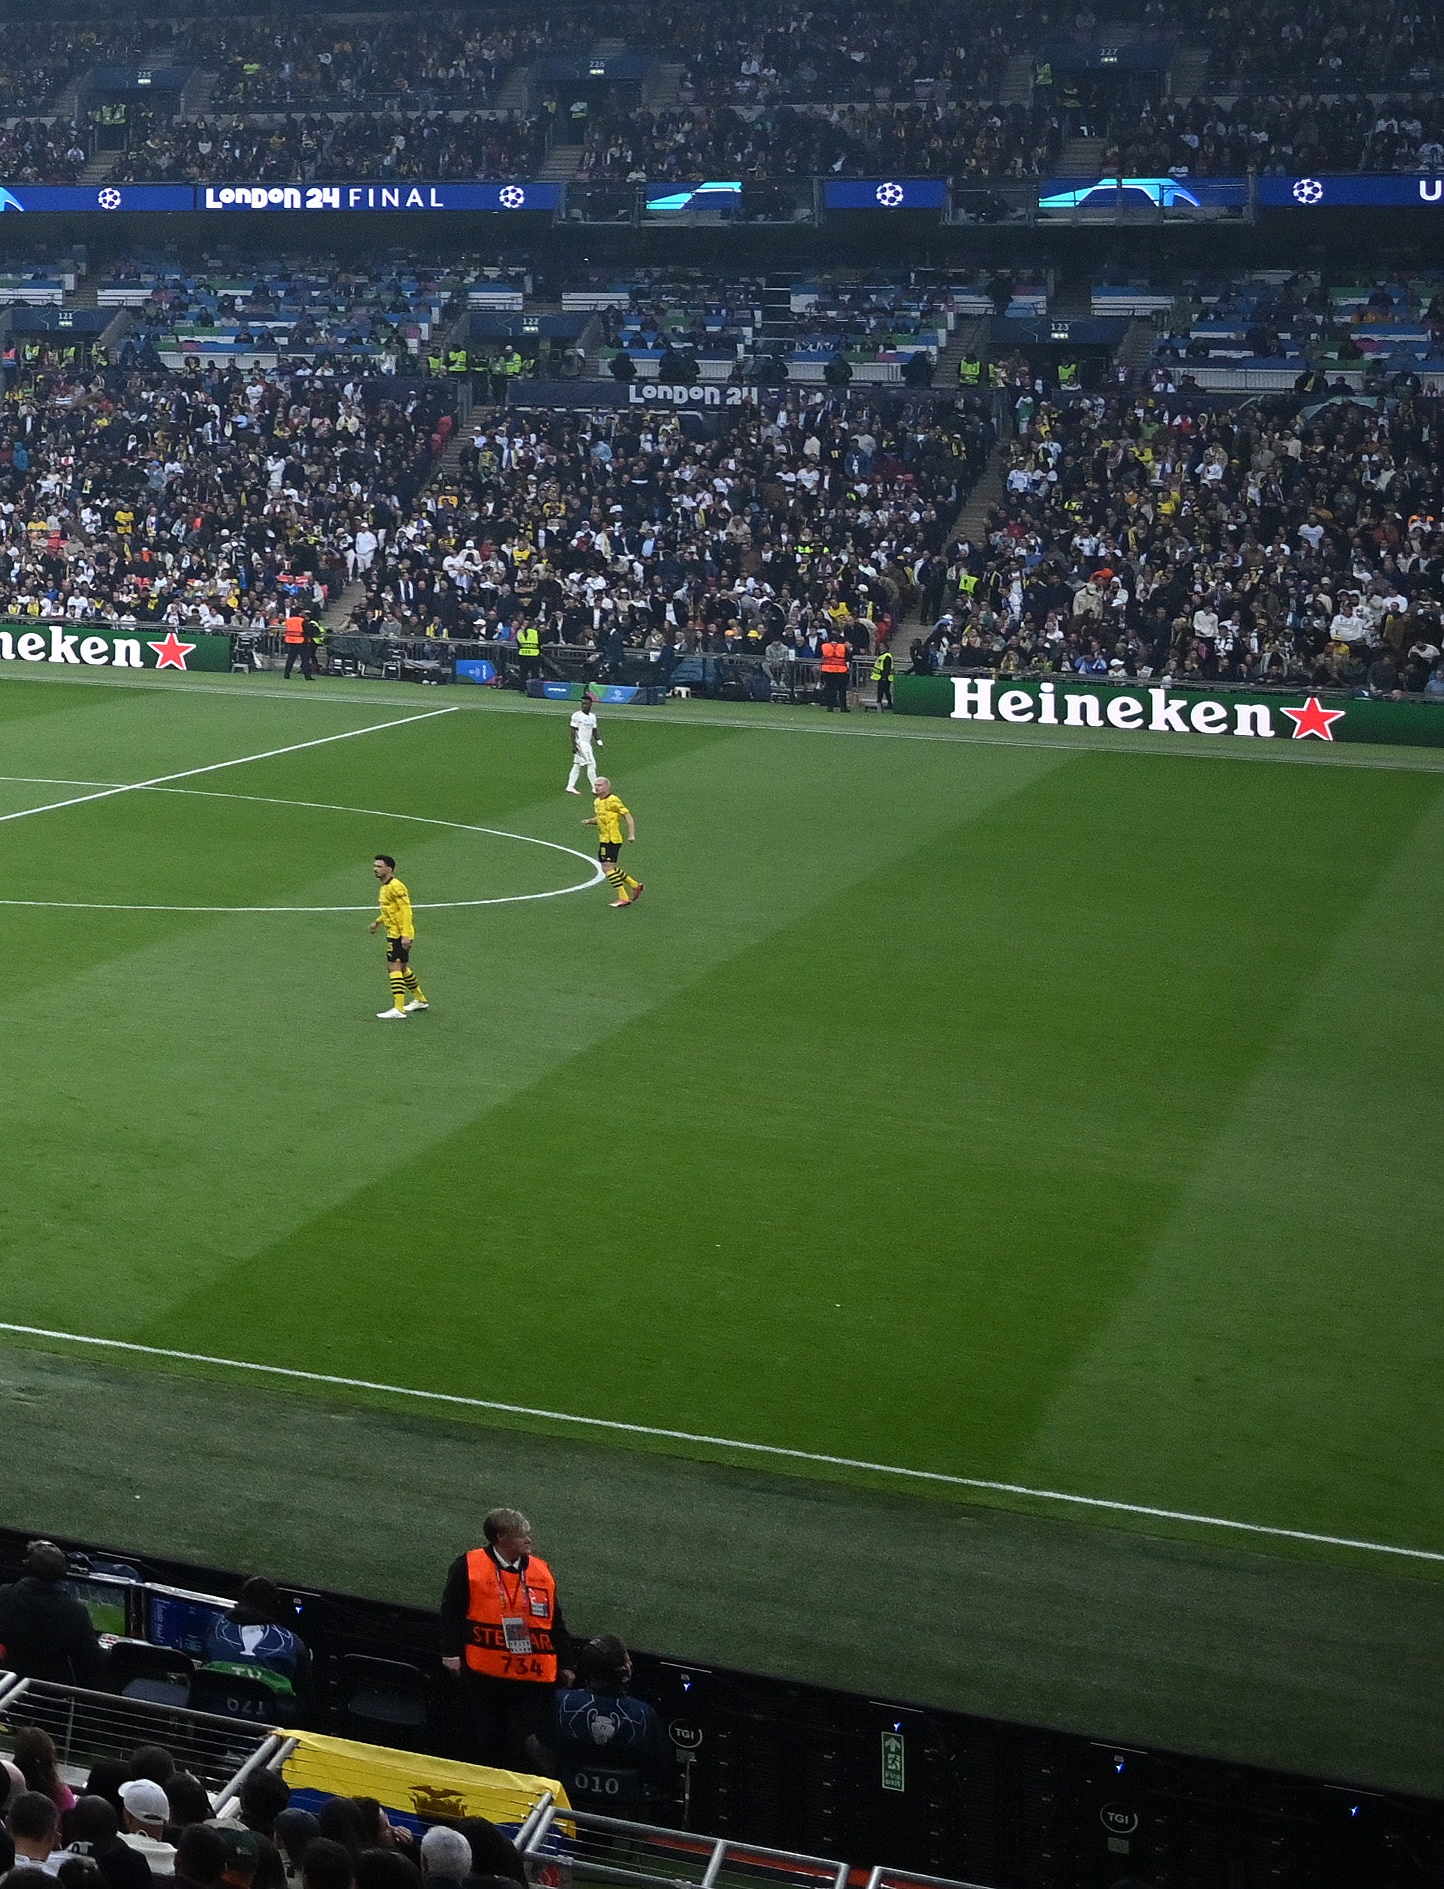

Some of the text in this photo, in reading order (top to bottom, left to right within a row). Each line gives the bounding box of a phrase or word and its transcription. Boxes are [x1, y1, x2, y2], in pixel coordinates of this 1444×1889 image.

[1100, 48, 1118, 56] 227
[589, 60, 605, 68] 226
[205, 188, 444, 209] London 24 FINAL
[522, 317, 539, 325] 122
[1051, 323, 1069, 331] 123
[629, 384, 720, 405] London
[724, 385, 758, 406] 24
[950, 676, 1276, 740] Heineken
[472, 1626, 554, 1653] STEAR
[500, 1655, 544, 1677] 734
[675, 1726, 694, 1740] TGI
[574, 1773, 619, 1795] 010
[1107, 1811, 1129, 1825] TGI
